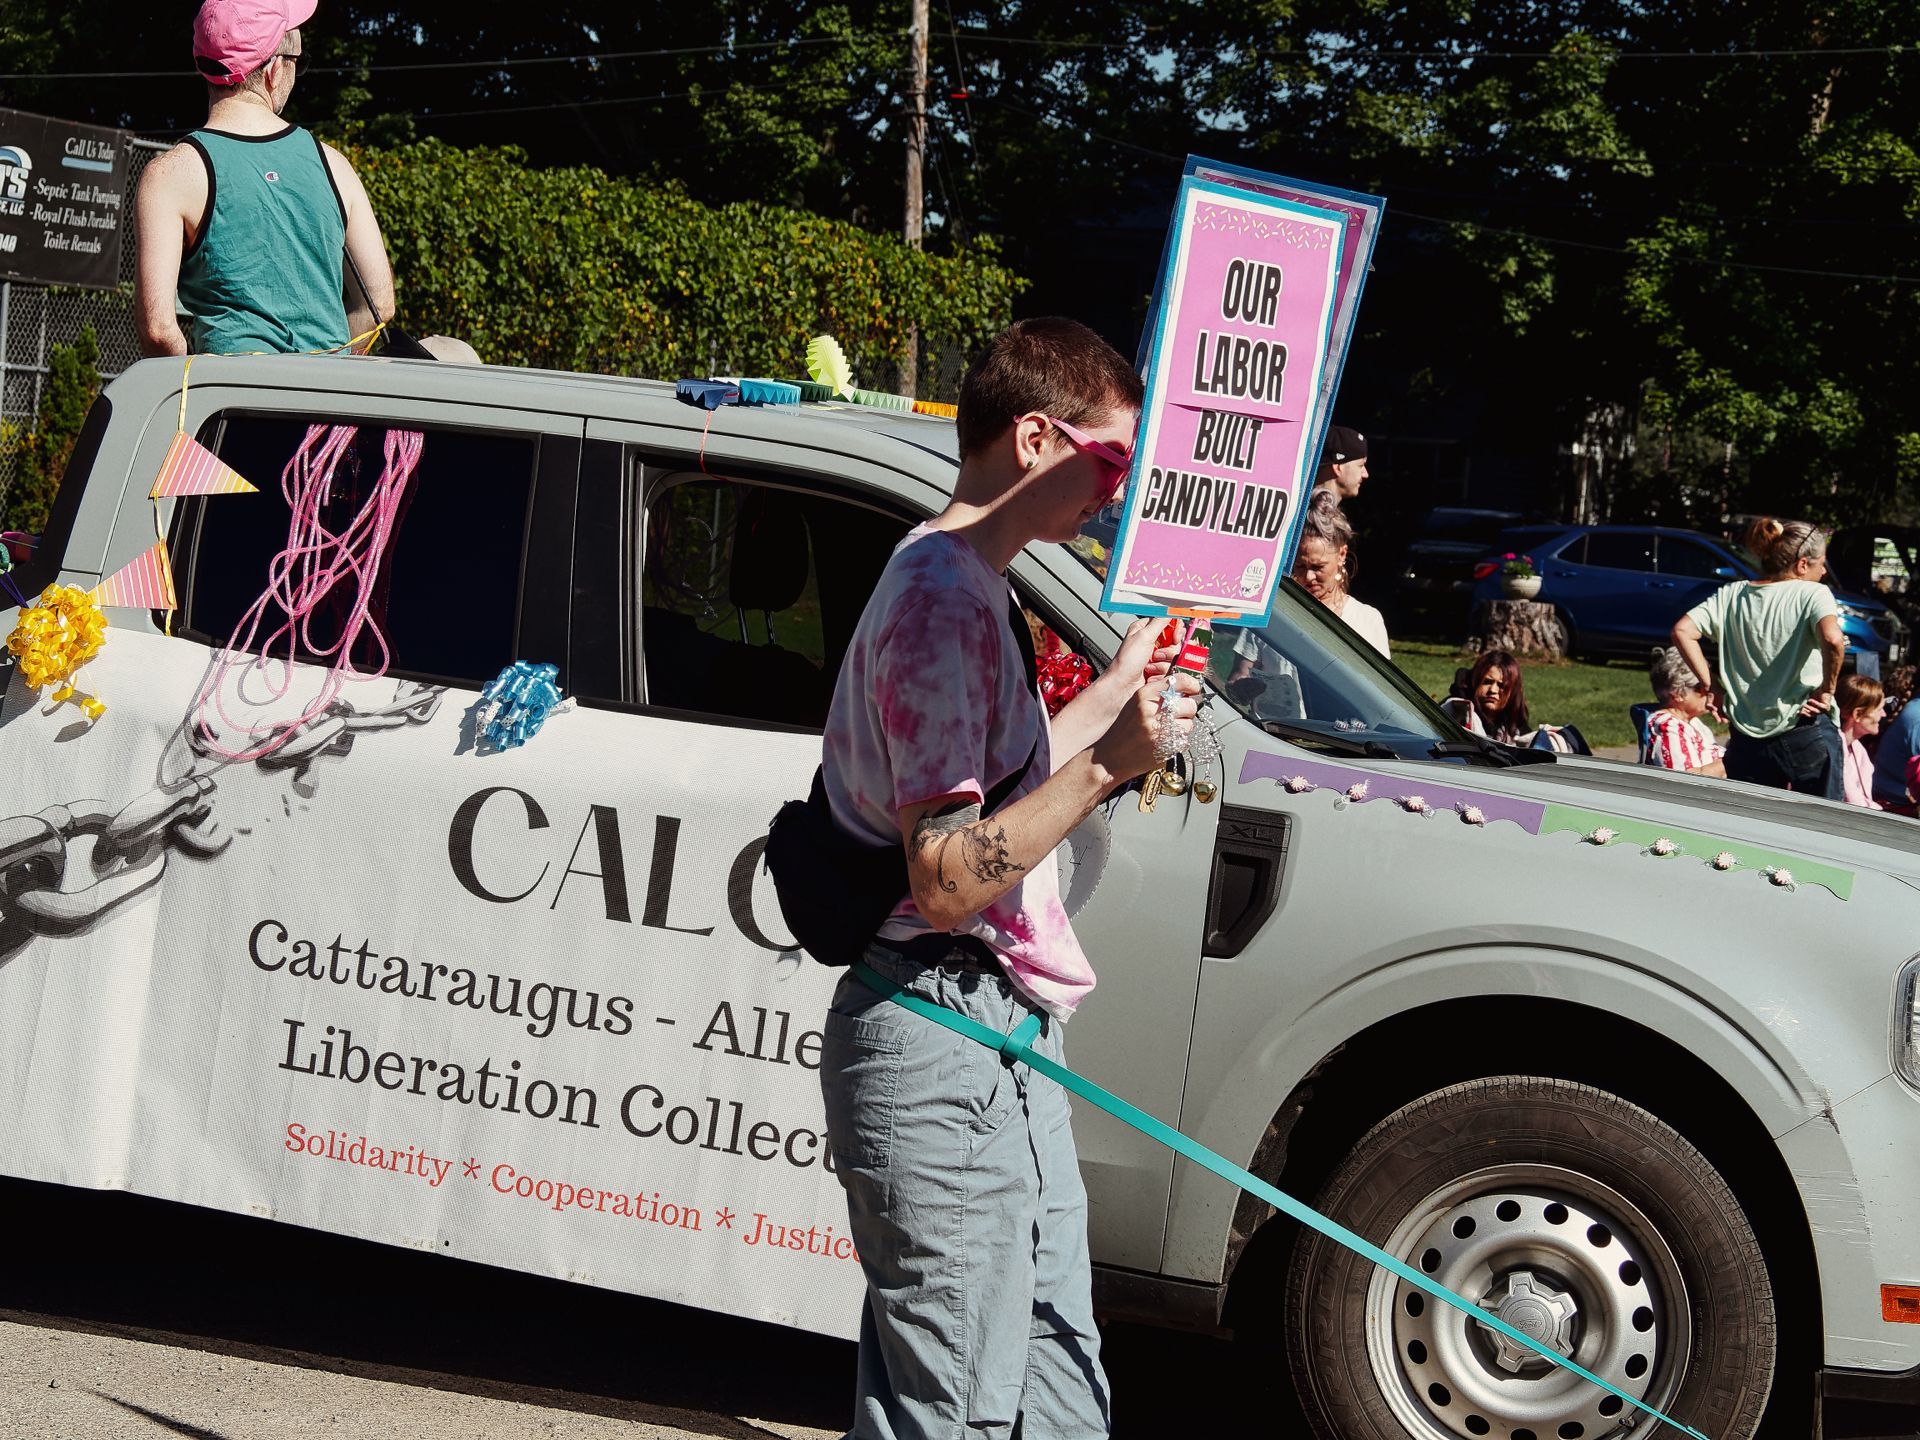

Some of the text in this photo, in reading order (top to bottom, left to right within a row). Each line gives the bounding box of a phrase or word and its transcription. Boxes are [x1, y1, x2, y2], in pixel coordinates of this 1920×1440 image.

[65, 137, 87, 156] Call
[86, 140, 97, 158] Us
[9, 202, 25, 216] LLC
[63, 208, 87, 228] Flush
[87, 211, 117, 229] Portable
[71, 183, 90, 203] Tank
[91, 186, 121, 210] Pumping
[44, 231, 101, 253] Toilet Rentals
[1221, 259, 1282, 327] OUR
[1194, 331, 1288, 405] LABOR
[1193, 409, 1264, 471] BUILT
[1141, 467, 1289, 539] CANDYLAND
[1228, 824, 1274, 843] XL
[248, 919, 634, 1038] Cattaraugus
[278, 1018, 601, 1128] Liberation
[285, 1122, 454, 1187] Solidarity
[491, 1163, 703, 1231] Cooperation
